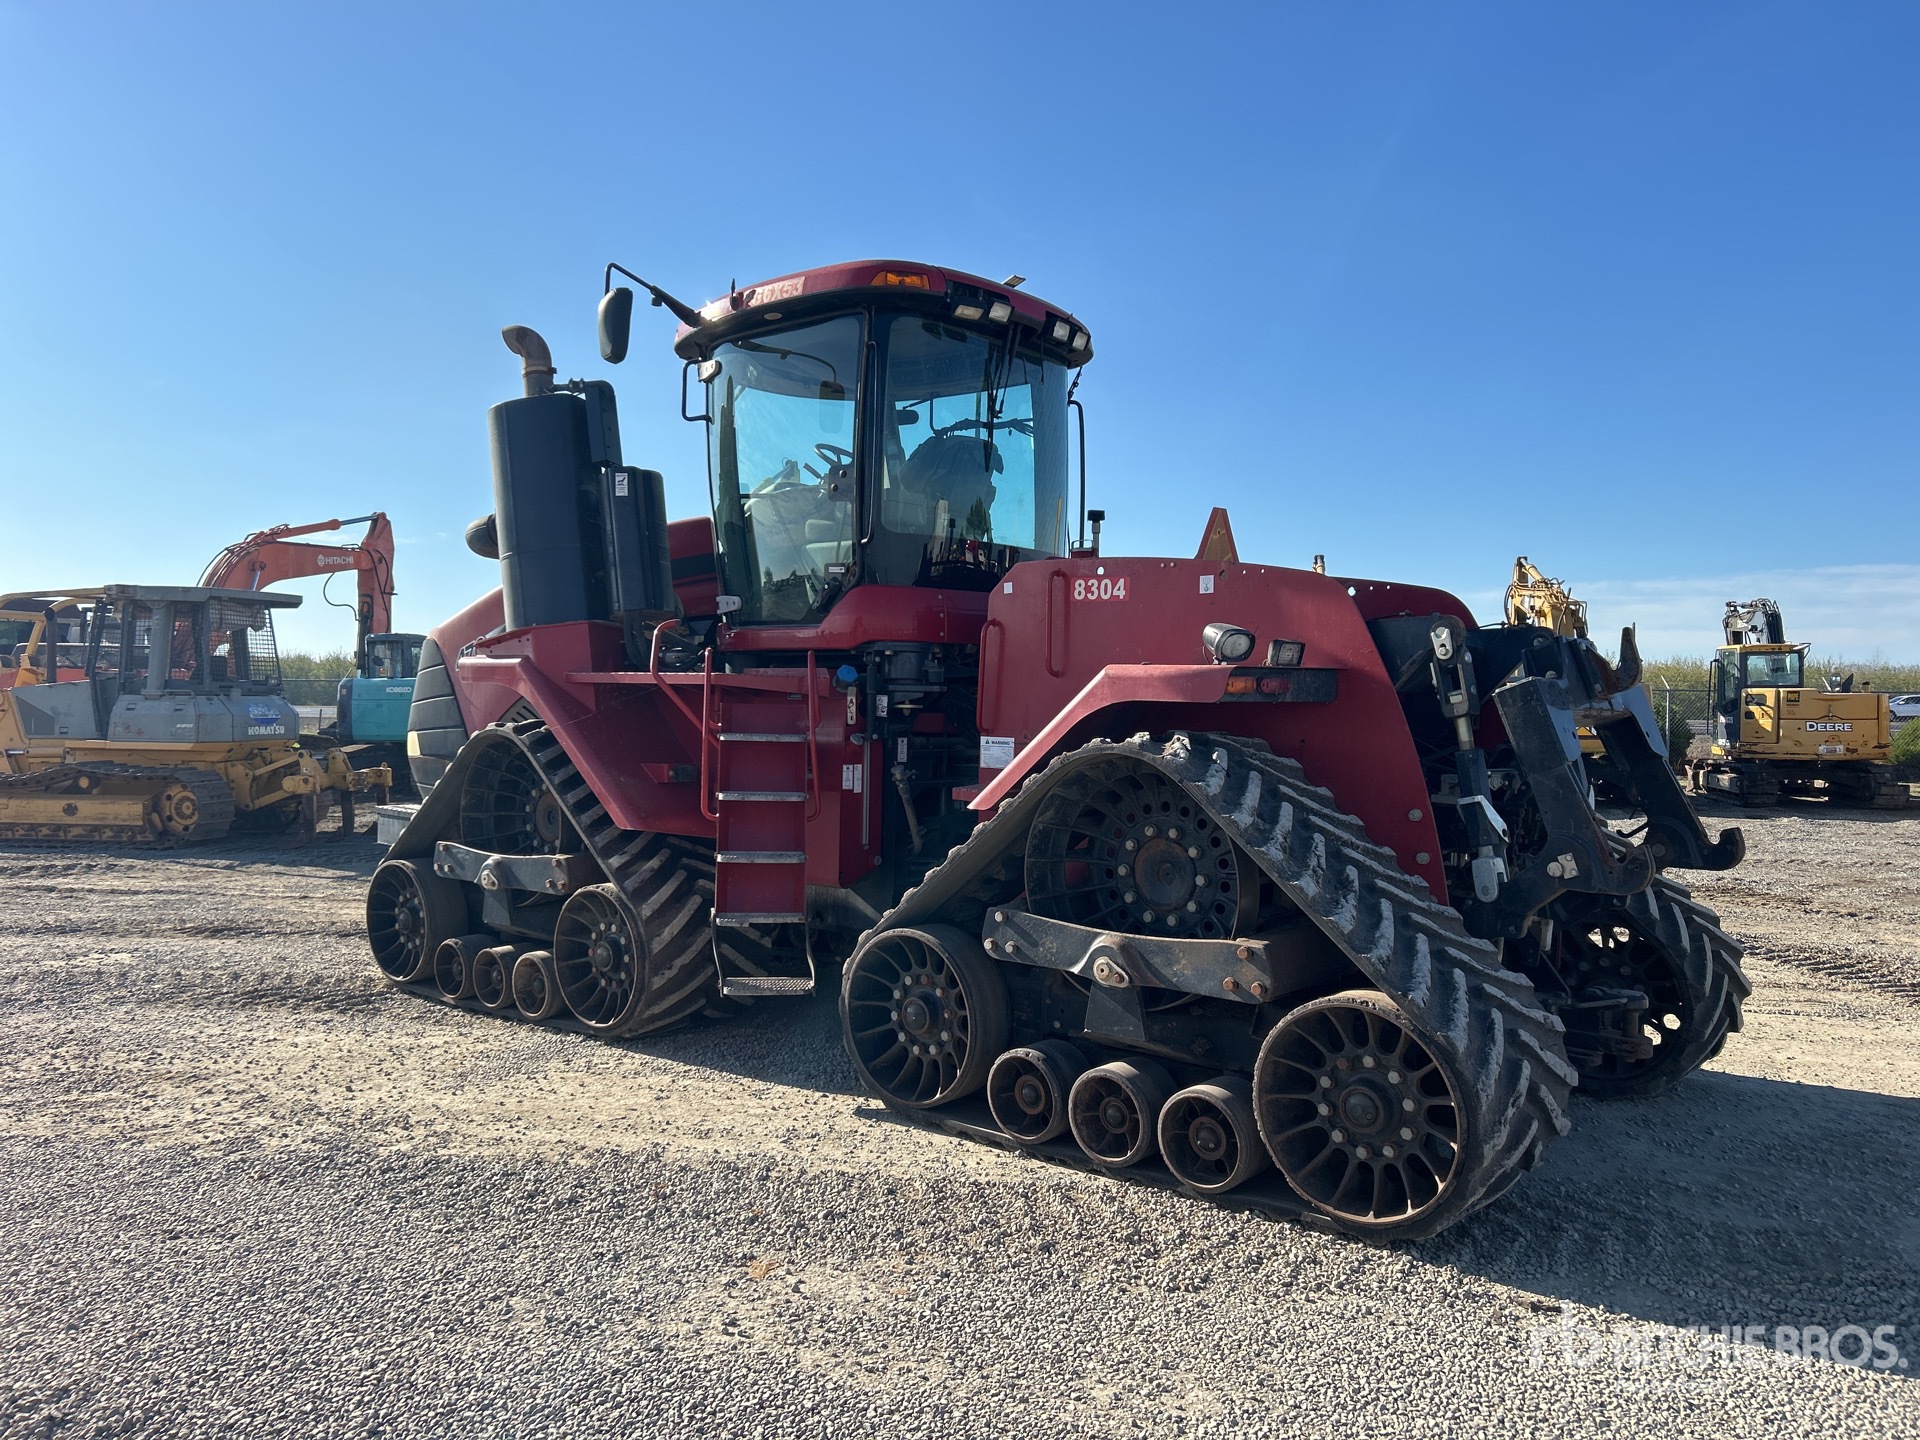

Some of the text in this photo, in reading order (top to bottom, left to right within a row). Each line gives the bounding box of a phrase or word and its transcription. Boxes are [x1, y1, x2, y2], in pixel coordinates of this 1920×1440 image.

[325, 556, 354, 565] HITACHI
[1073, 578, 1126, 600] 8304
[248, 723, 285, 735] KOMATSU
[1806, 721, 1853, 731] DEERE
